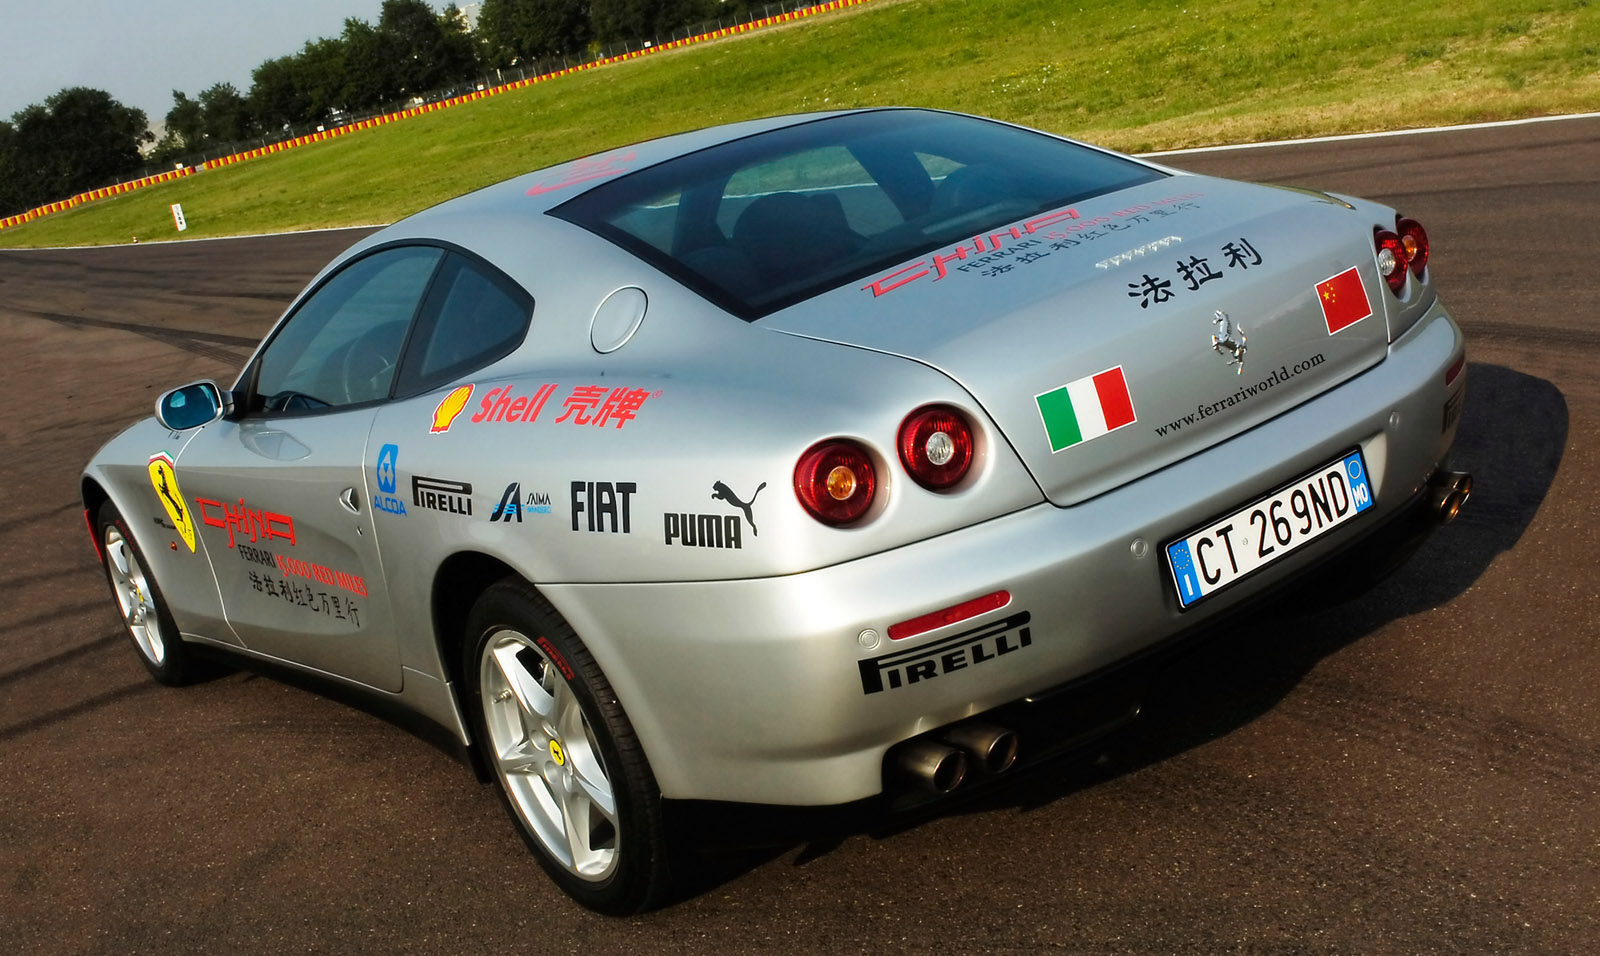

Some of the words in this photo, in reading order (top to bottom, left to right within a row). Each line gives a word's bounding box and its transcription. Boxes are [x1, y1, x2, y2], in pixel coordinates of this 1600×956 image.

[957, 239, 1043, 273] FERRARI
[1127, 237, 1264, 309] 法拉利
[471, 384, 558, 423] Shell
[555, 386, 651, 429] 壳牌
[1154, 353, 1326, 438] www.ferrariworld.com
[374, 495, 408, 516] ALCOA
[412, 475, 473, 516] PIRELLI
[571, 481, 637, 533] FIAT
[1352, 483, 1369, 507] MO
[664, 512, 743, 549] PUMA
[1196, 524, 1239, 585] CT
[238, 544, 276, 568] FERRARI
[311, 563, 335, 586] RED
[335, 570, 369, 597] MILES
[249, 571, 360, 628] 法拉利红色万里行
[858, 610, 1032, 695] PIRELLI
